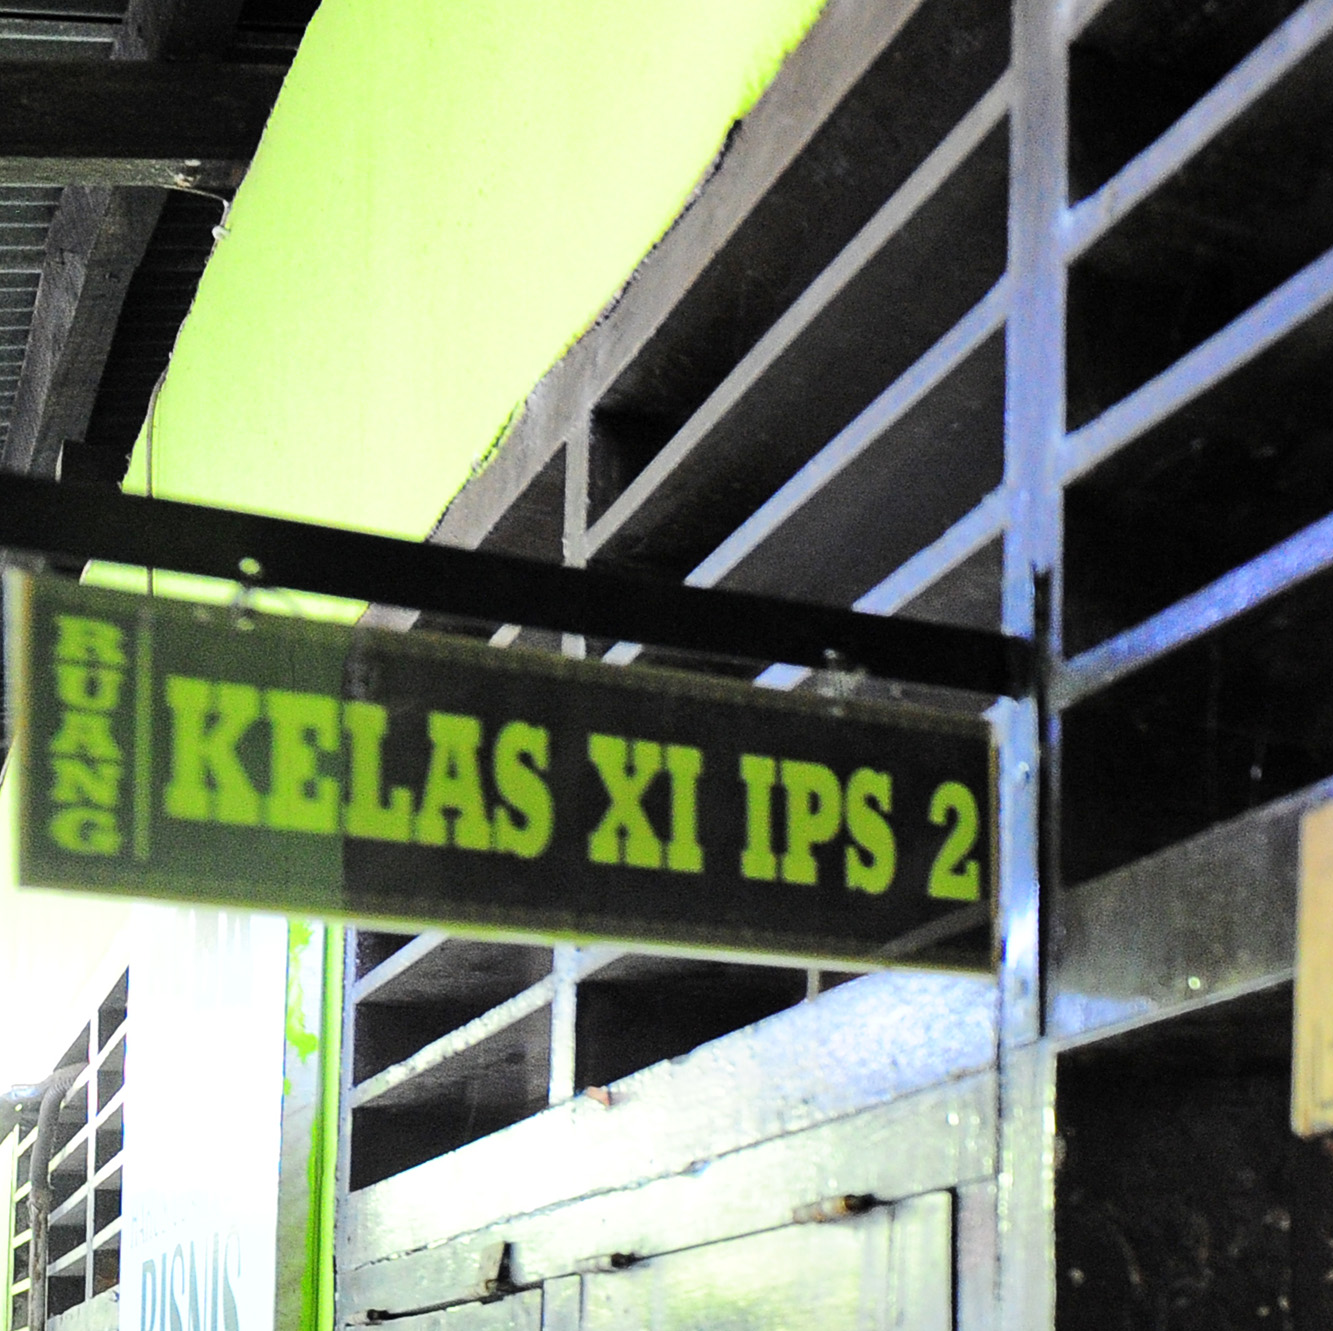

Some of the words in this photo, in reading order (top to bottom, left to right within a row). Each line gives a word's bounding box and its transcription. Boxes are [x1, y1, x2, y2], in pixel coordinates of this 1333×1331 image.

[50, 612, 126, 857] RUANG
[163, 674, 553, 858] KELAS
[588, 734, 705, 874] XI
[740, 755, 896, 899] IPS
[928, 781, 981, 902] 2
